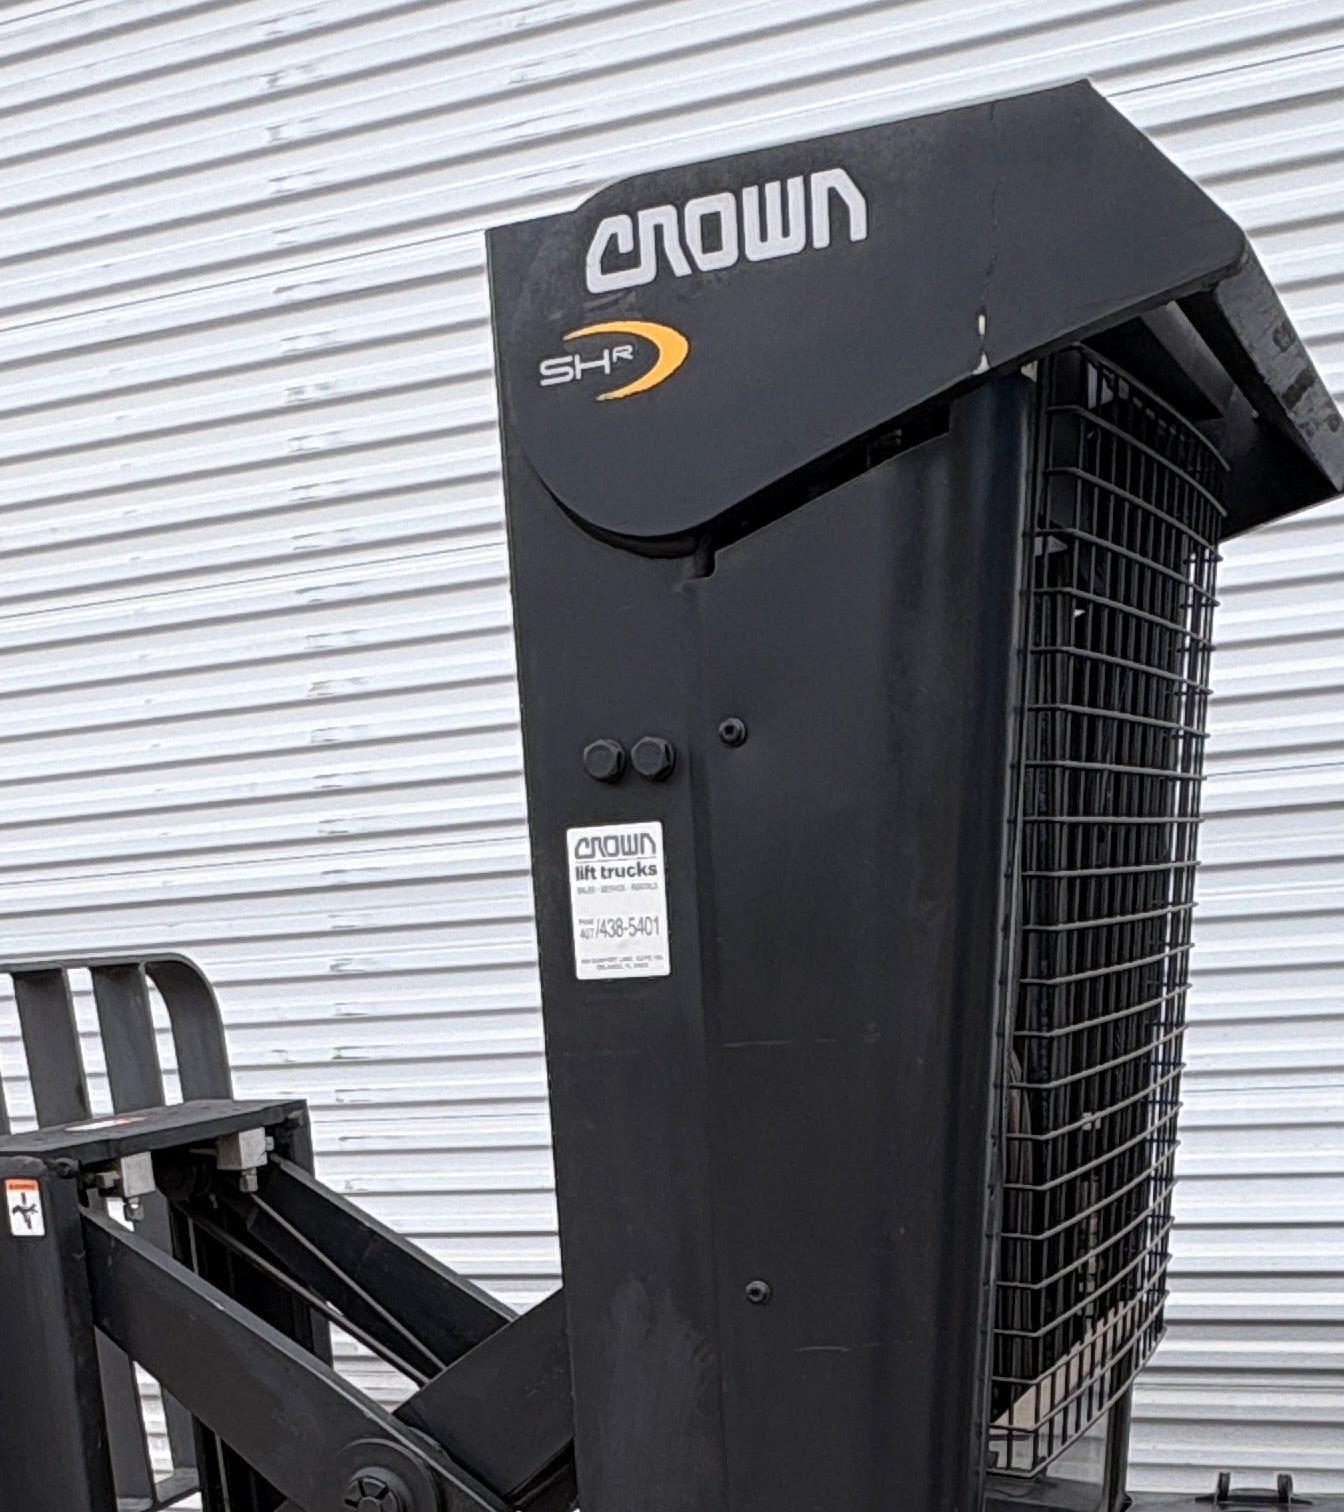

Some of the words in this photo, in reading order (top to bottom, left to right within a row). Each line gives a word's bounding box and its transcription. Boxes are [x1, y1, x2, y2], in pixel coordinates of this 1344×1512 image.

[586, 167, 868, 294] CROWN
[575, 833, 656, 859] CROWN
[576, 865, 597, 880] lift
[601, 861, 657, 879] trucks
